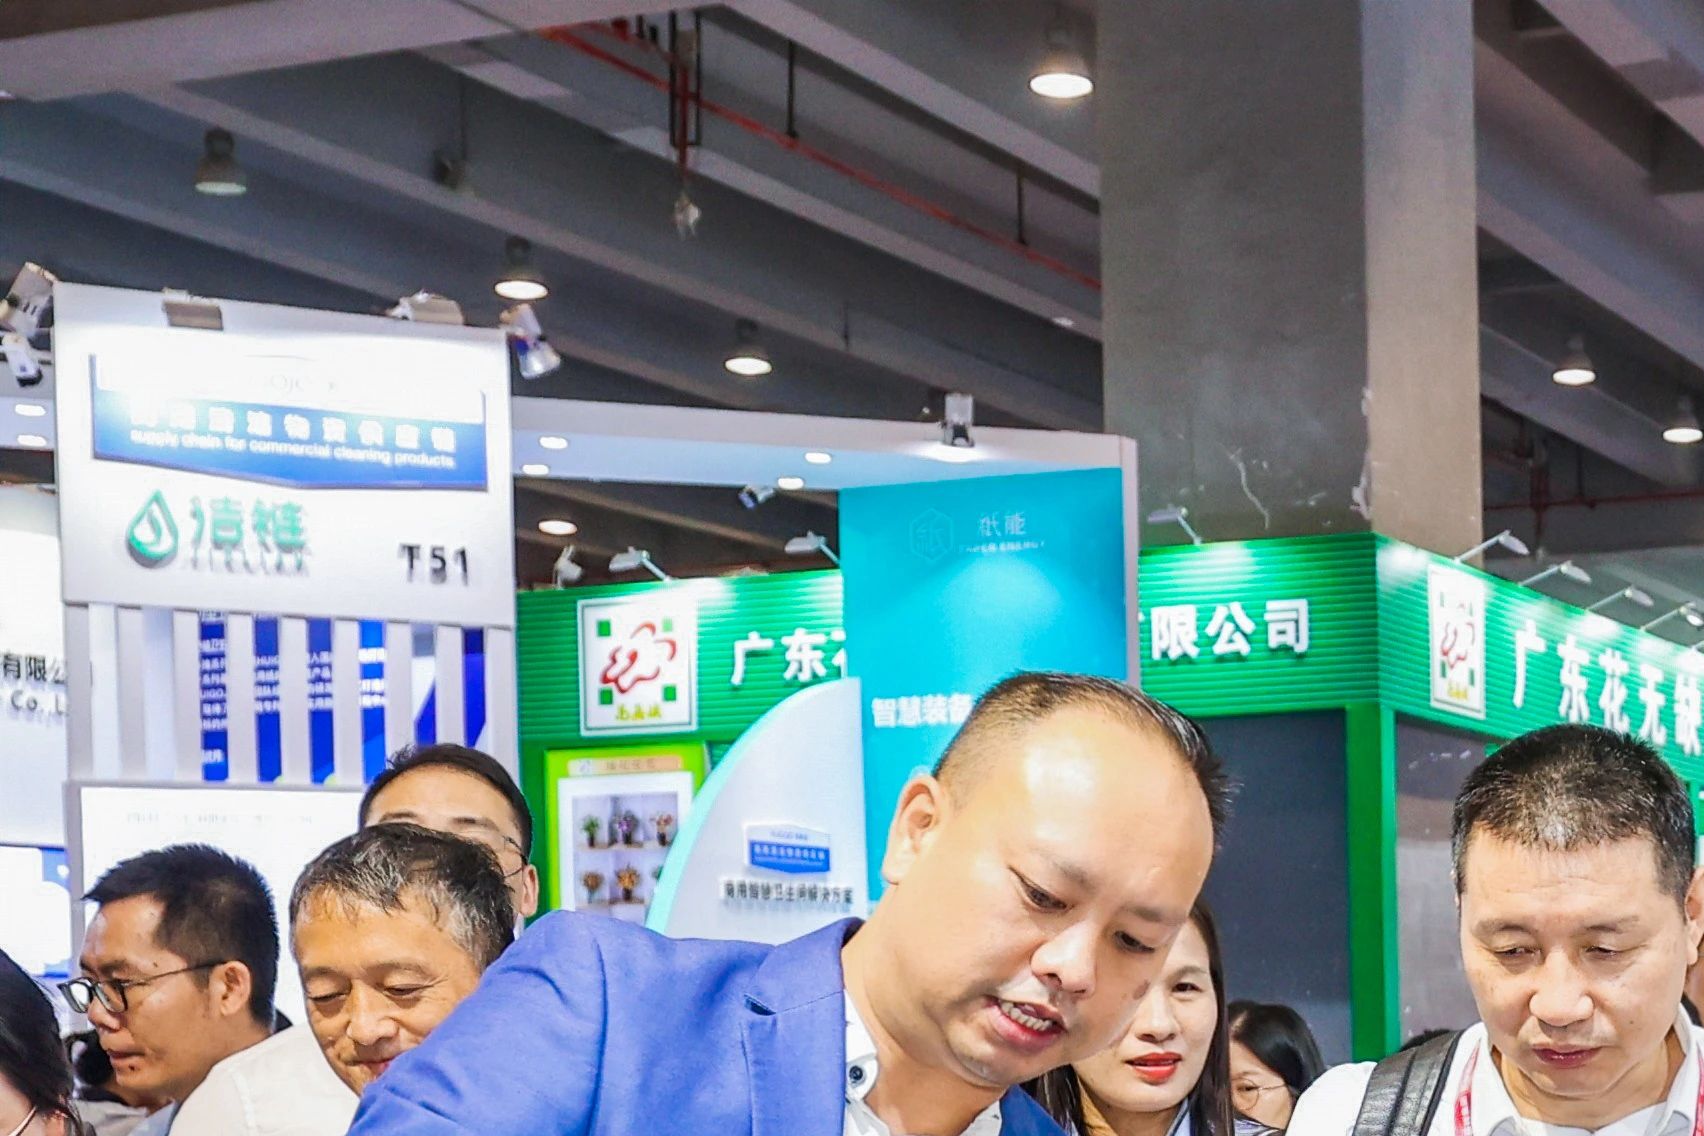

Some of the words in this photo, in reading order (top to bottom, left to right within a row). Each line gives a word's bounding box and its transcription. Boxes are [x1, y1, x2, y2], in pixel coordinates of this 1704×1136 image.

[225, 437, 246, 452] for
[250, 440, 330, 459] commercial
[335, 445, 390, 467] cleaning
[394, 452, 456, 469] products
[399, 544, 468, 577] T51
[1138, 598, 1309, 661] 限公司
